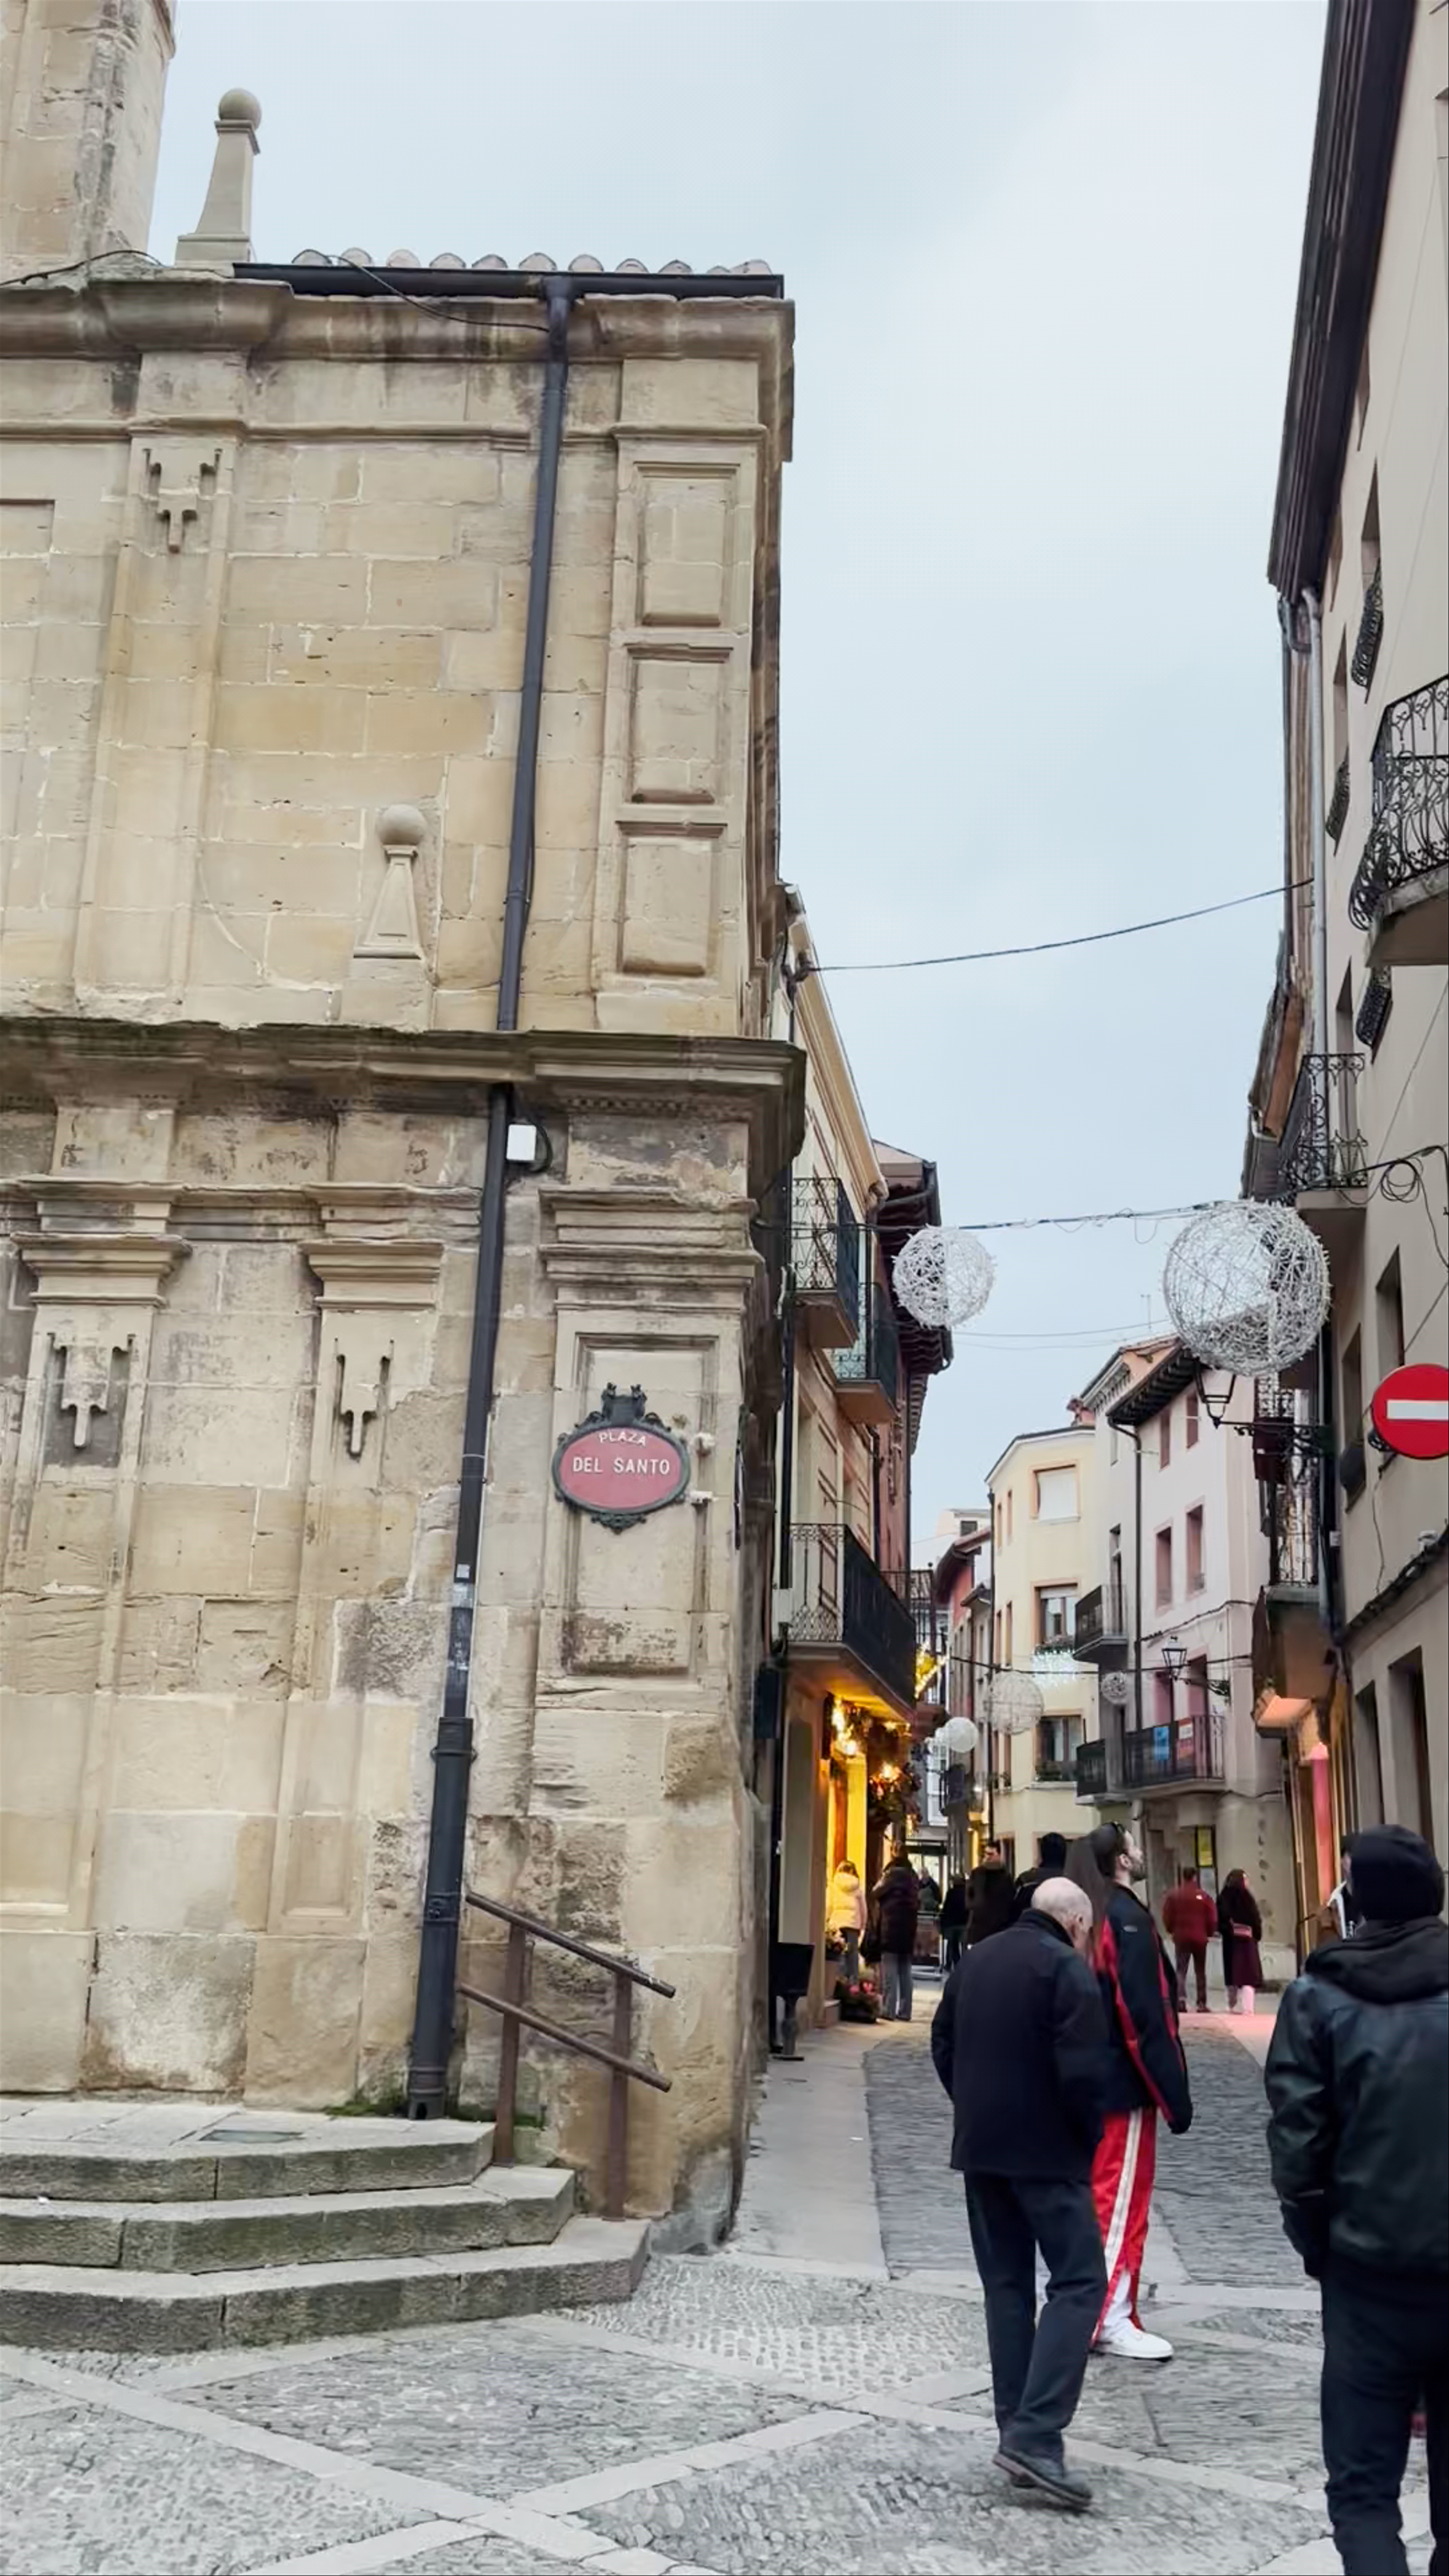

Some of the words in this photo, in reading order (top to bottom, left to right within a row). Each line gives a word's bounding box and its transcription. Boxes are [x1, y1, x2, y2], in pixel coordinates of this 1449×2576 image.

[599, 1431, 646, 1446] PLAZA
[573, 1457, 603, 1472] DEL
[614, 1458, 670, 1475] SANTO
